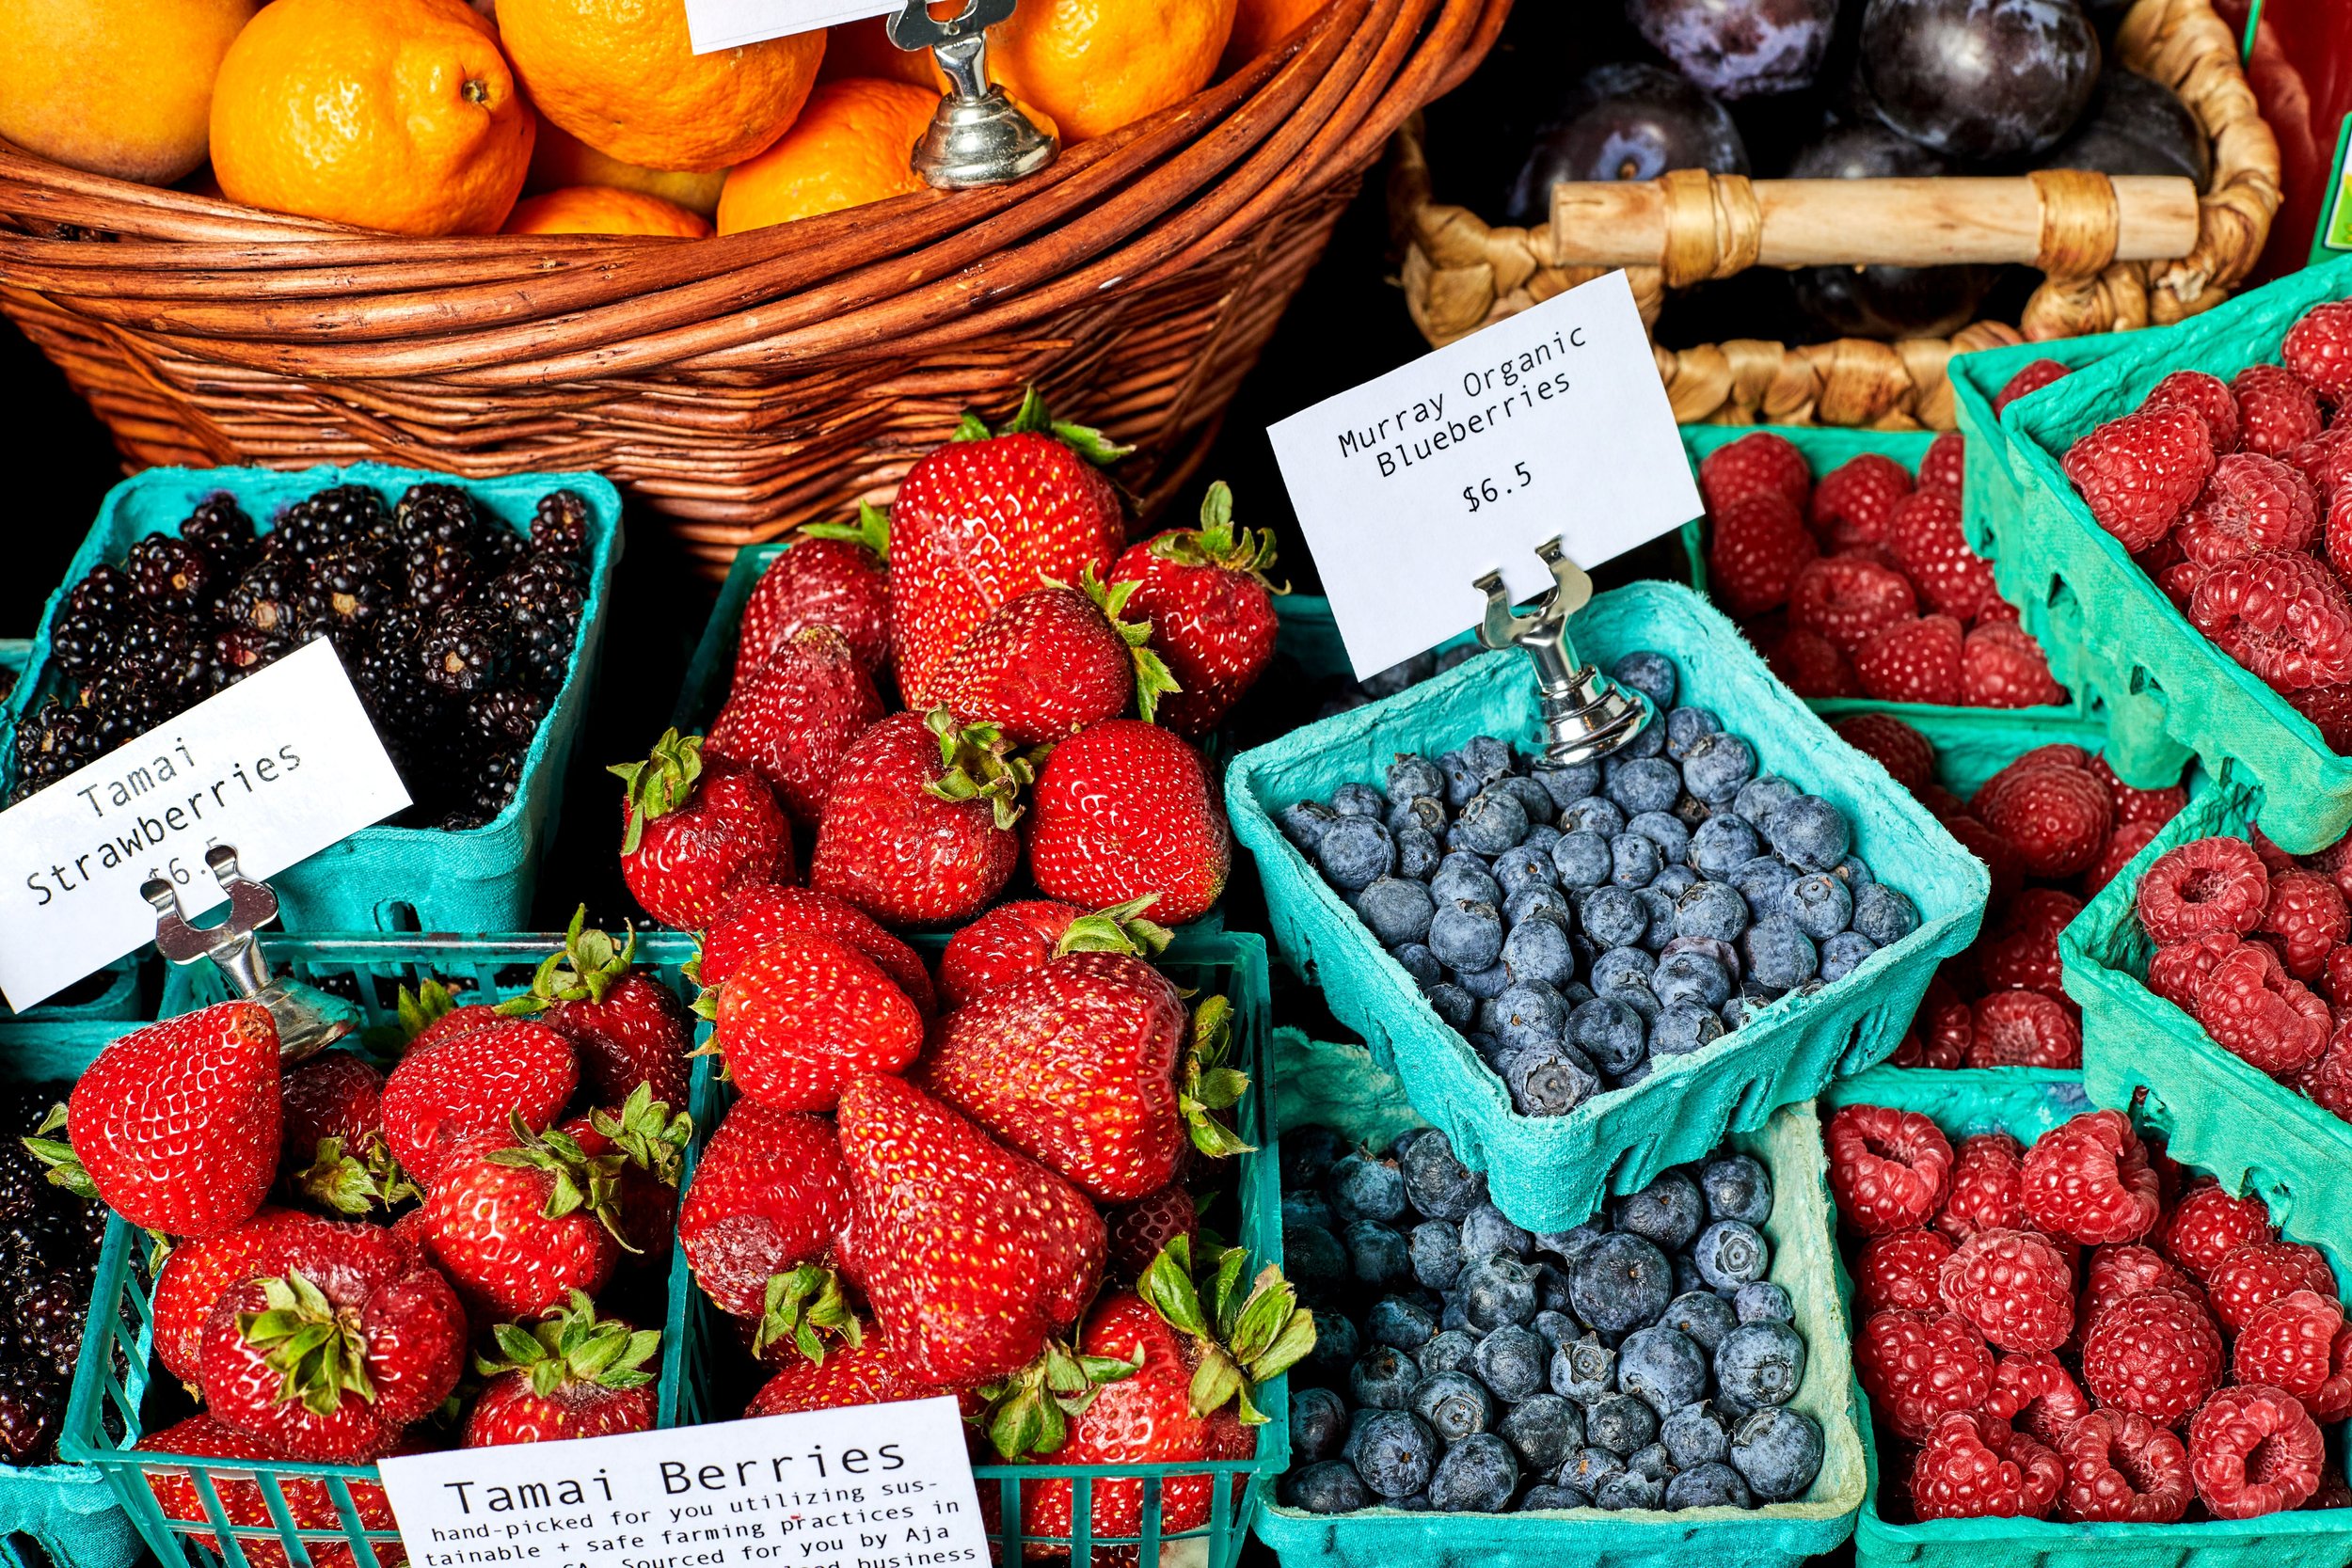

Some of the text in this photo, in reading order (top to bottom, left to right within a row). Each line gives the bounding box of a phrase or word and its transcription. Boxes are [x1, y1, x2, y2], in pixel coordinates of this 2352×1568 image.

[1337, 326, 1586, 458] Murray Organic
[1376, 371, 1571, 478] Blueberries
[1462, 461, 1533, 513] $6.5
[77, 736, 195, 817] Tamai
[26, 744, 302, 906] Strawberries
[431, 1481, 937, 1543] hand-picked for you utilizing sus-
[443, 1444, 904, 1514] Tamai Berries
[425, 1499, 960, 1567] tainable + safe farming practices in
[622, 1527, 949, 1568] Sourced for you by Aja
[857, 1548, 976, 1568] business
